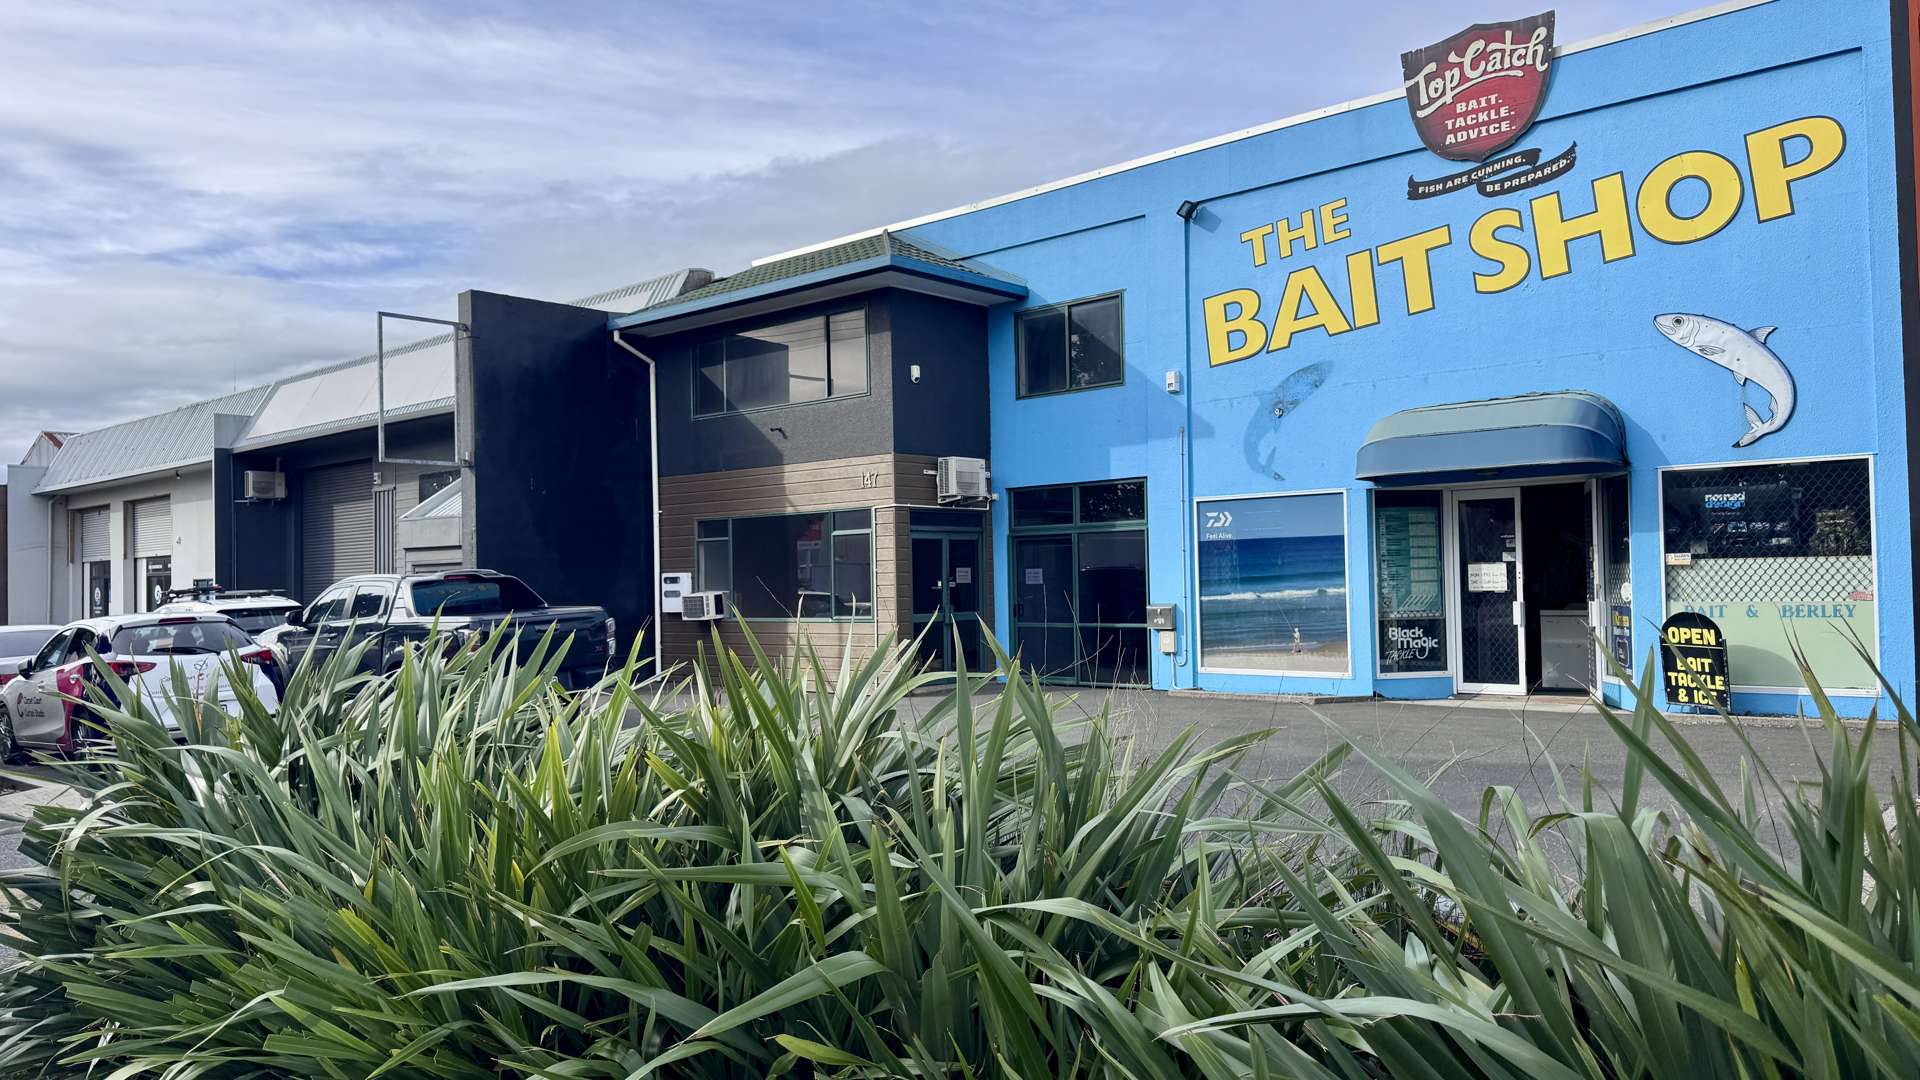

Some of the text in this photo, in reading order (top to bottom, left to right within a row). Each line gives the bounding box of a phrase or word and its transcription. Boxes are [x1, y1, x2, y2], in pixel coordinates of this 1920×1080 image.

[1404, 26, 1549, 106] Top Catch
[1455, 93, 1503, 114] BAIT.
[1444, 105, 1516, 130] TACKLE.
[1444, 120, 1517, 145] ADVICE.
[1418, 155, 1526, 194] FISH ARE CUNNING.
[1486, 158, 1571, 193] BE PREPARED.
[1202, 114, 1847, 369] BAIT SHOP
[1240, 197, 1352, 268] THE
[861, 471, 881, 488] 147
[1704, 491, 1746, 502] nomad
[1745, 604, 1760, 618] &
[1781, 604, 1857, 618] BERLEY
[1389, 626, 1424, 641] Black
[1667, 626, 1716, 646] OPEN
[1385, 648, 1417, 665] TACKLE
[1678, 688, 1689, 703] &
